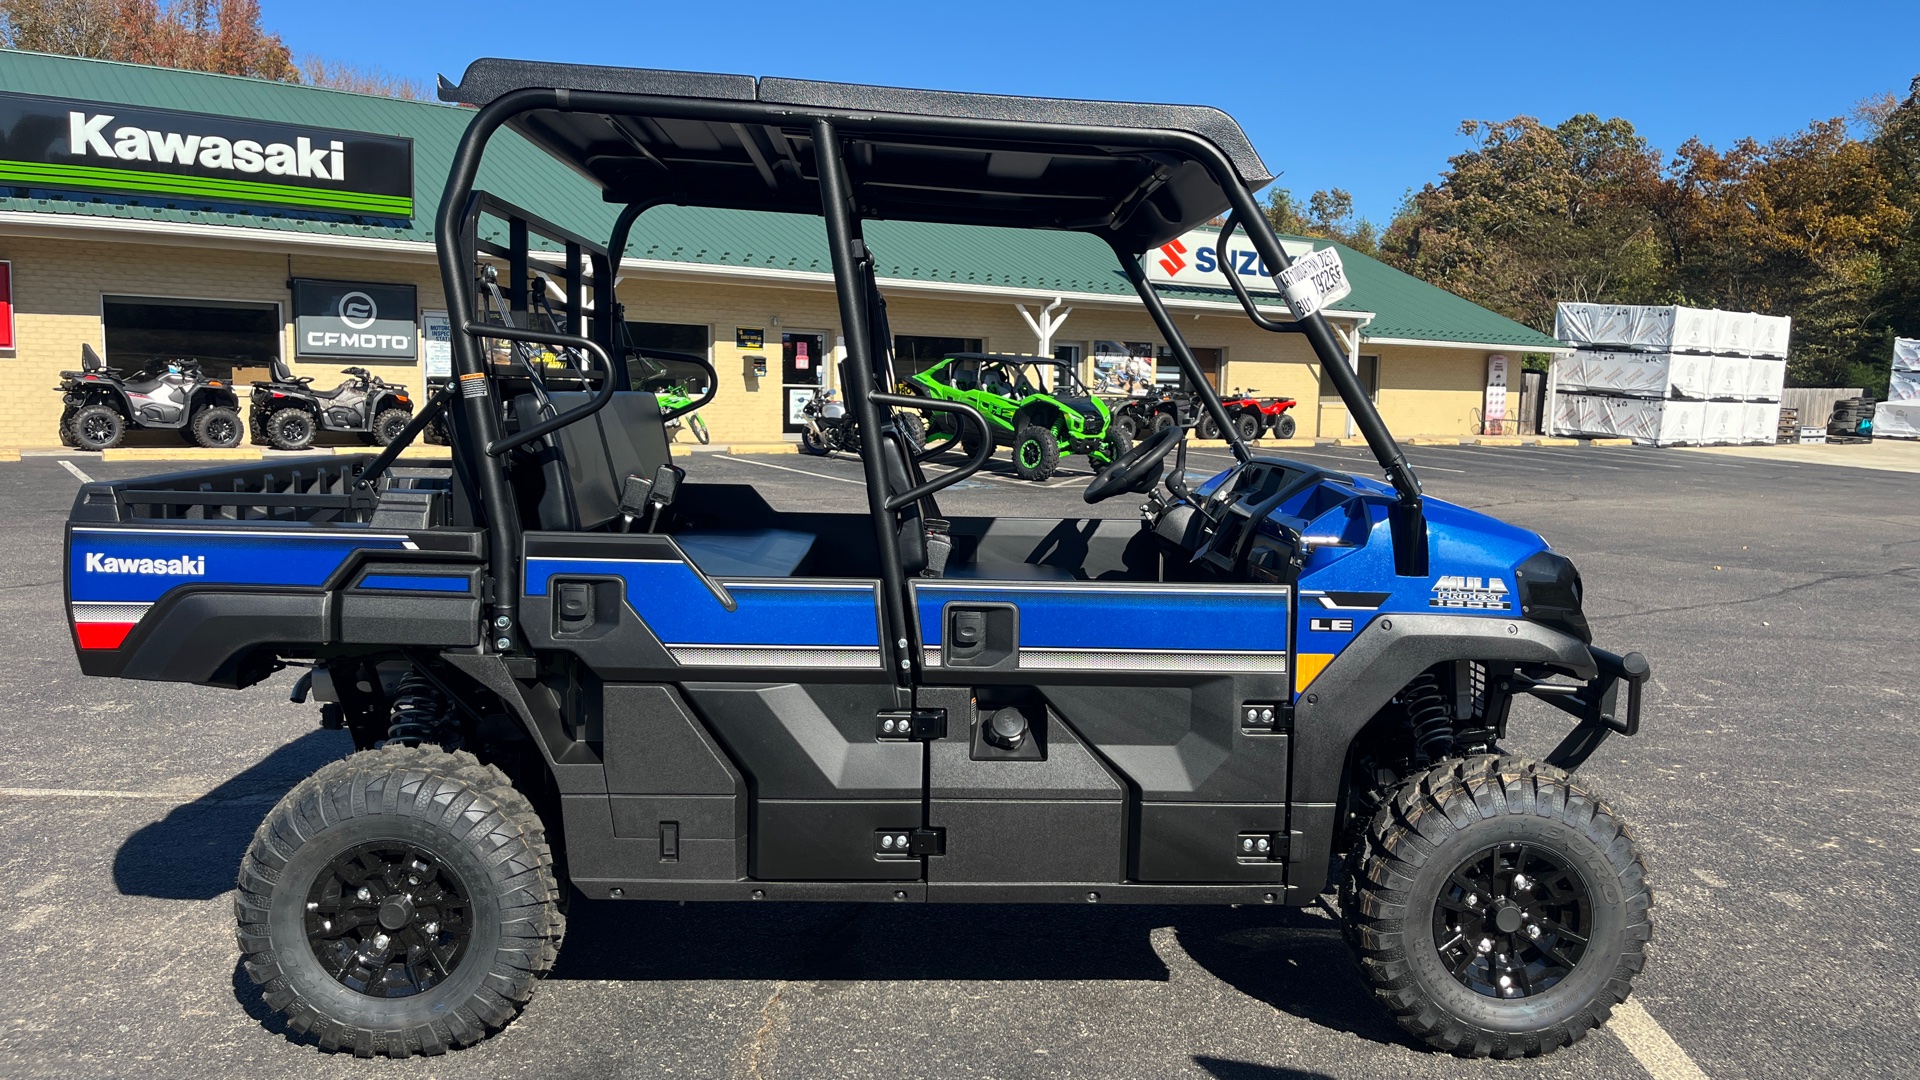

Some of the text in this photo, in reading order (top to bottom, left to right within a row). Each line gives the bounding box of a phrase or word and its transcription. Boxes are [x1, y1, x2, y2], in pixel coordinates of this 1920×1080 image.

[69, 111, 344, 181] Kawasaki
[1317, 250, 1336, 268] D251
[1295, 296, 1314, 315] BU1
[307, 331, 408, 349] CFMOTO
[86, 552, 205, 575] Kawasaki
[1310, 619, 1353, 631] LE
